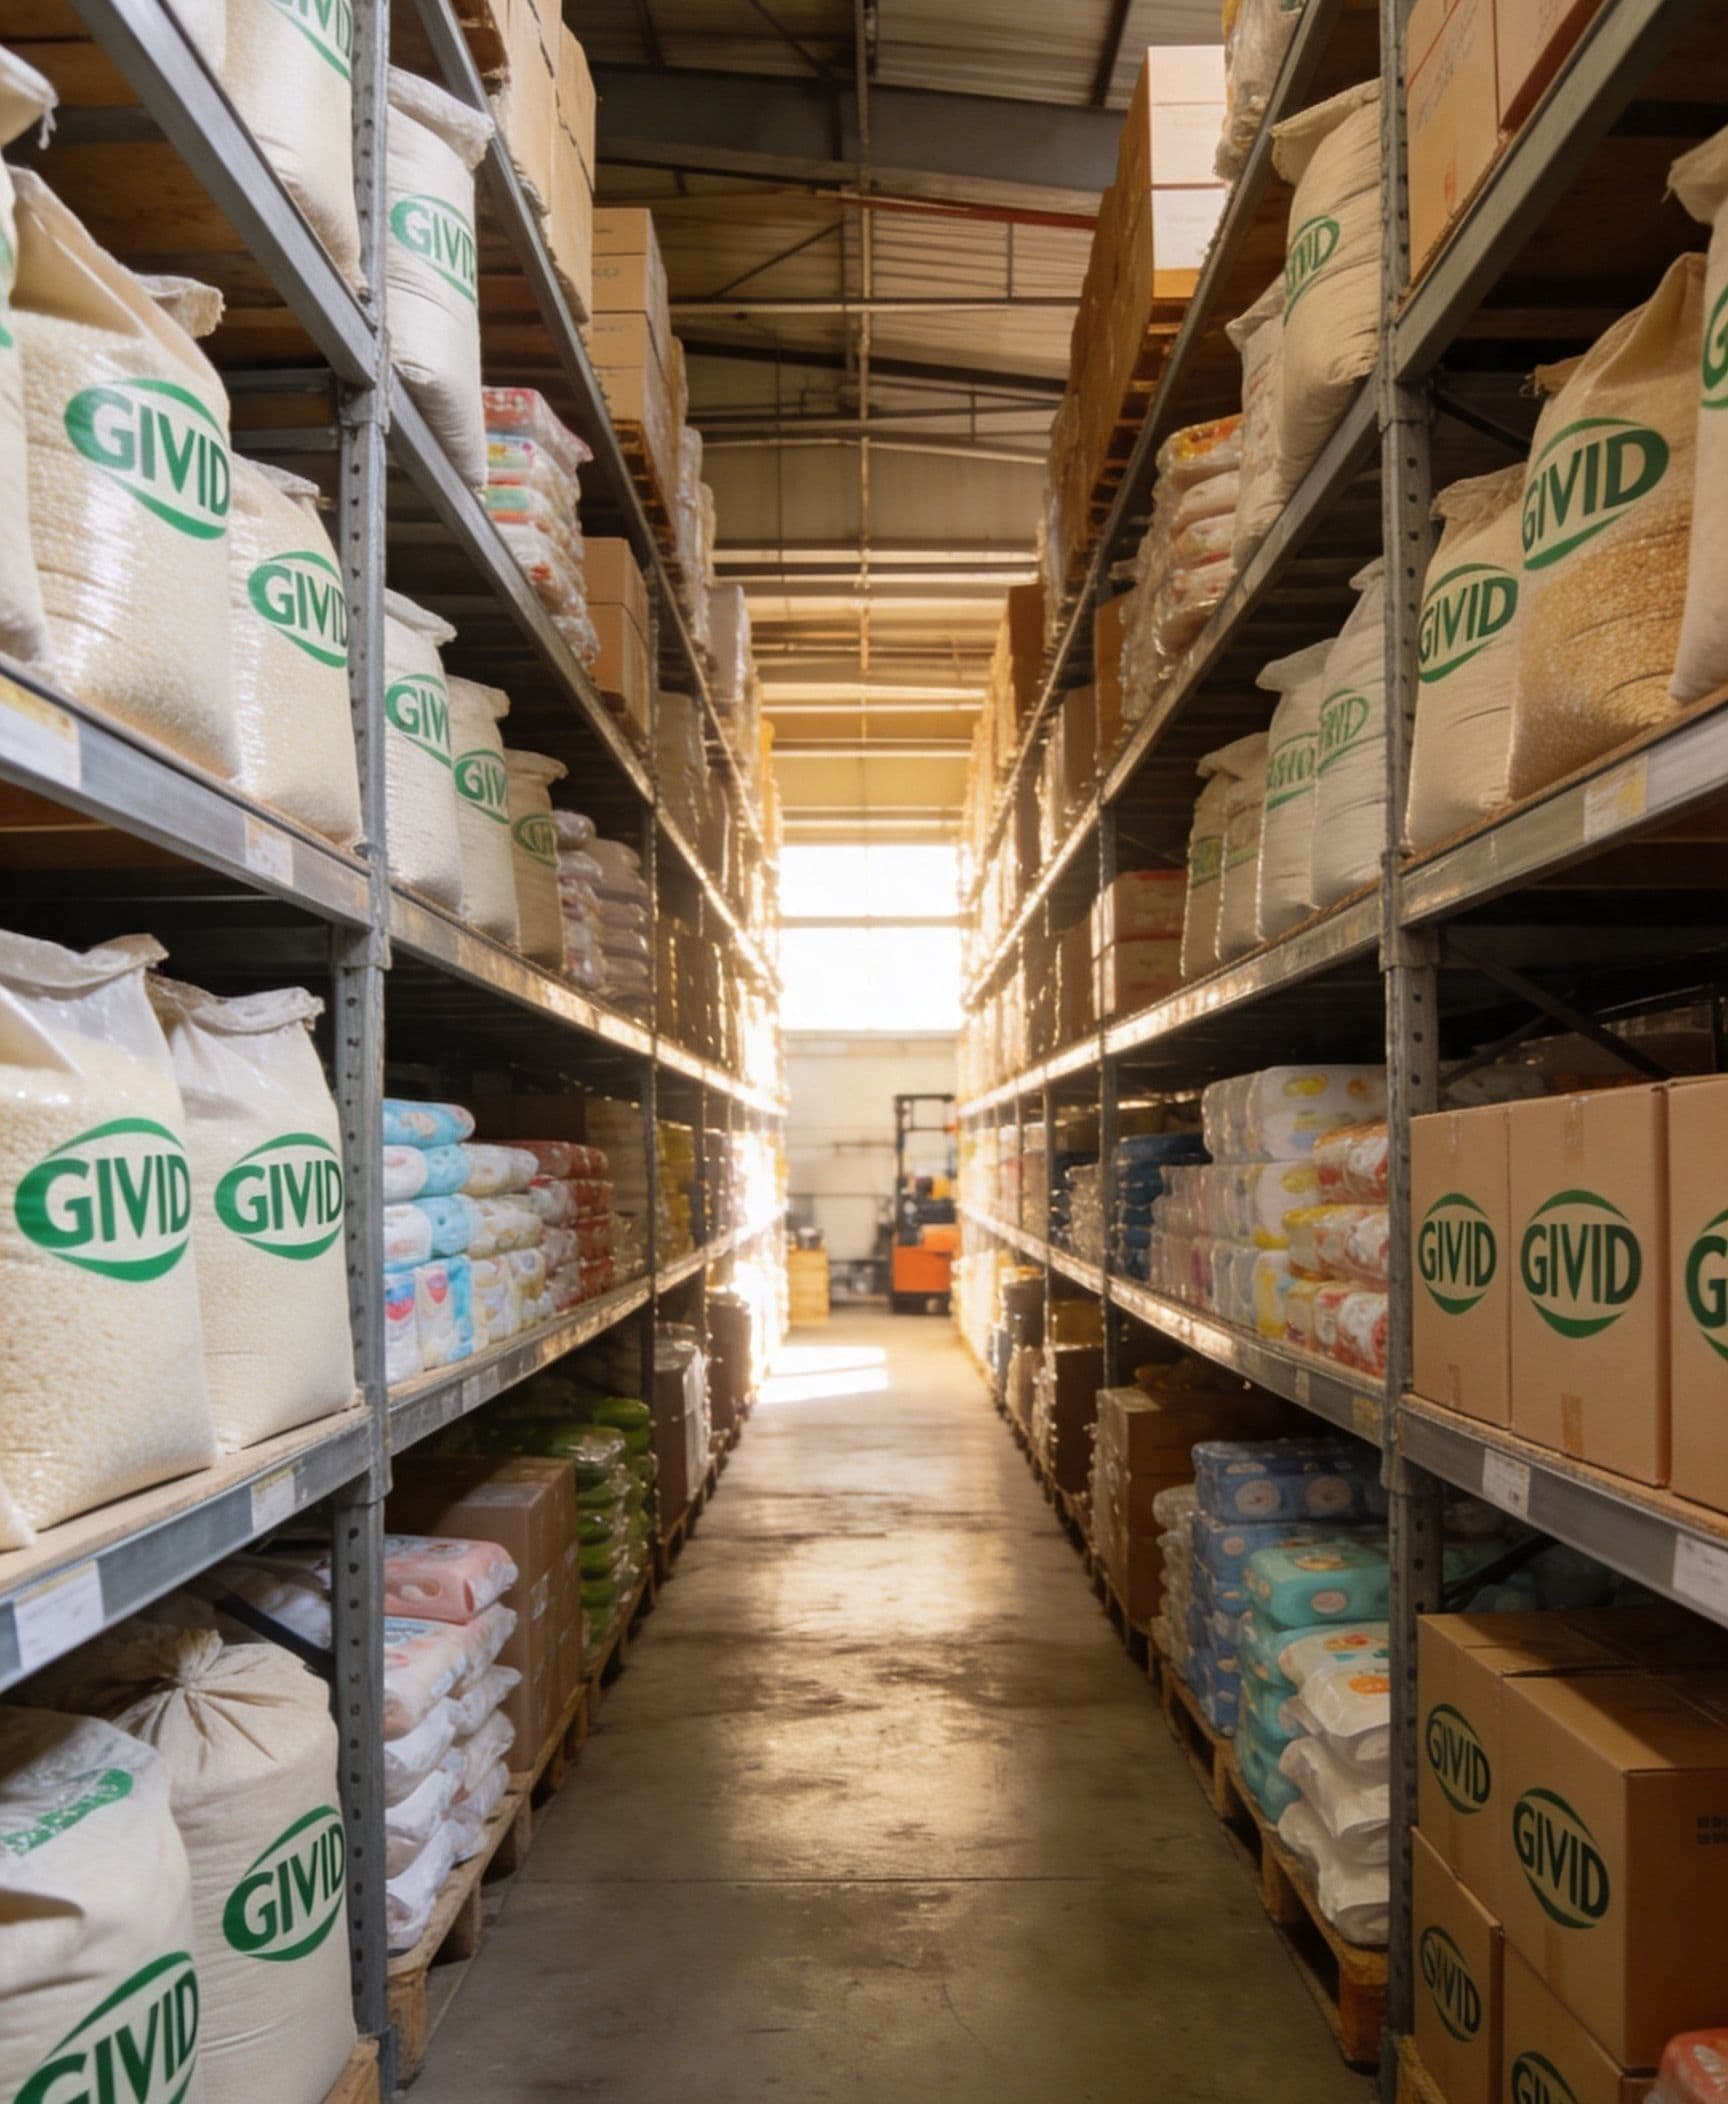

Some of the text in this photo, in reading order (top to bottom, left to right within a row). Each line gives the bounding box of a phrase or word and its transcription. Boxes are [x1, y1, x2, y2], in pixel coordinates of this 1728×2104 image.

[64, 387, 230, 517] GIVID
[1522, 428, 1669, 552] GIVID
[247, 564, 348, 648] GIVID
[1418, 576, 1518, 664] GIVID
[14, 1154, 191, 1249] GIVID
[214, 1160, 343, 1234] GIVID
[1418, 1221, 1497, 1287] GIVID
[1520, 1224, 1642, 1305] GIVID
[1427, 1719, 1491, 1804] GIVID
[222, 1822, 345, 1952] GIVID
[1513, 1801, 1610, 1919] GIVID
